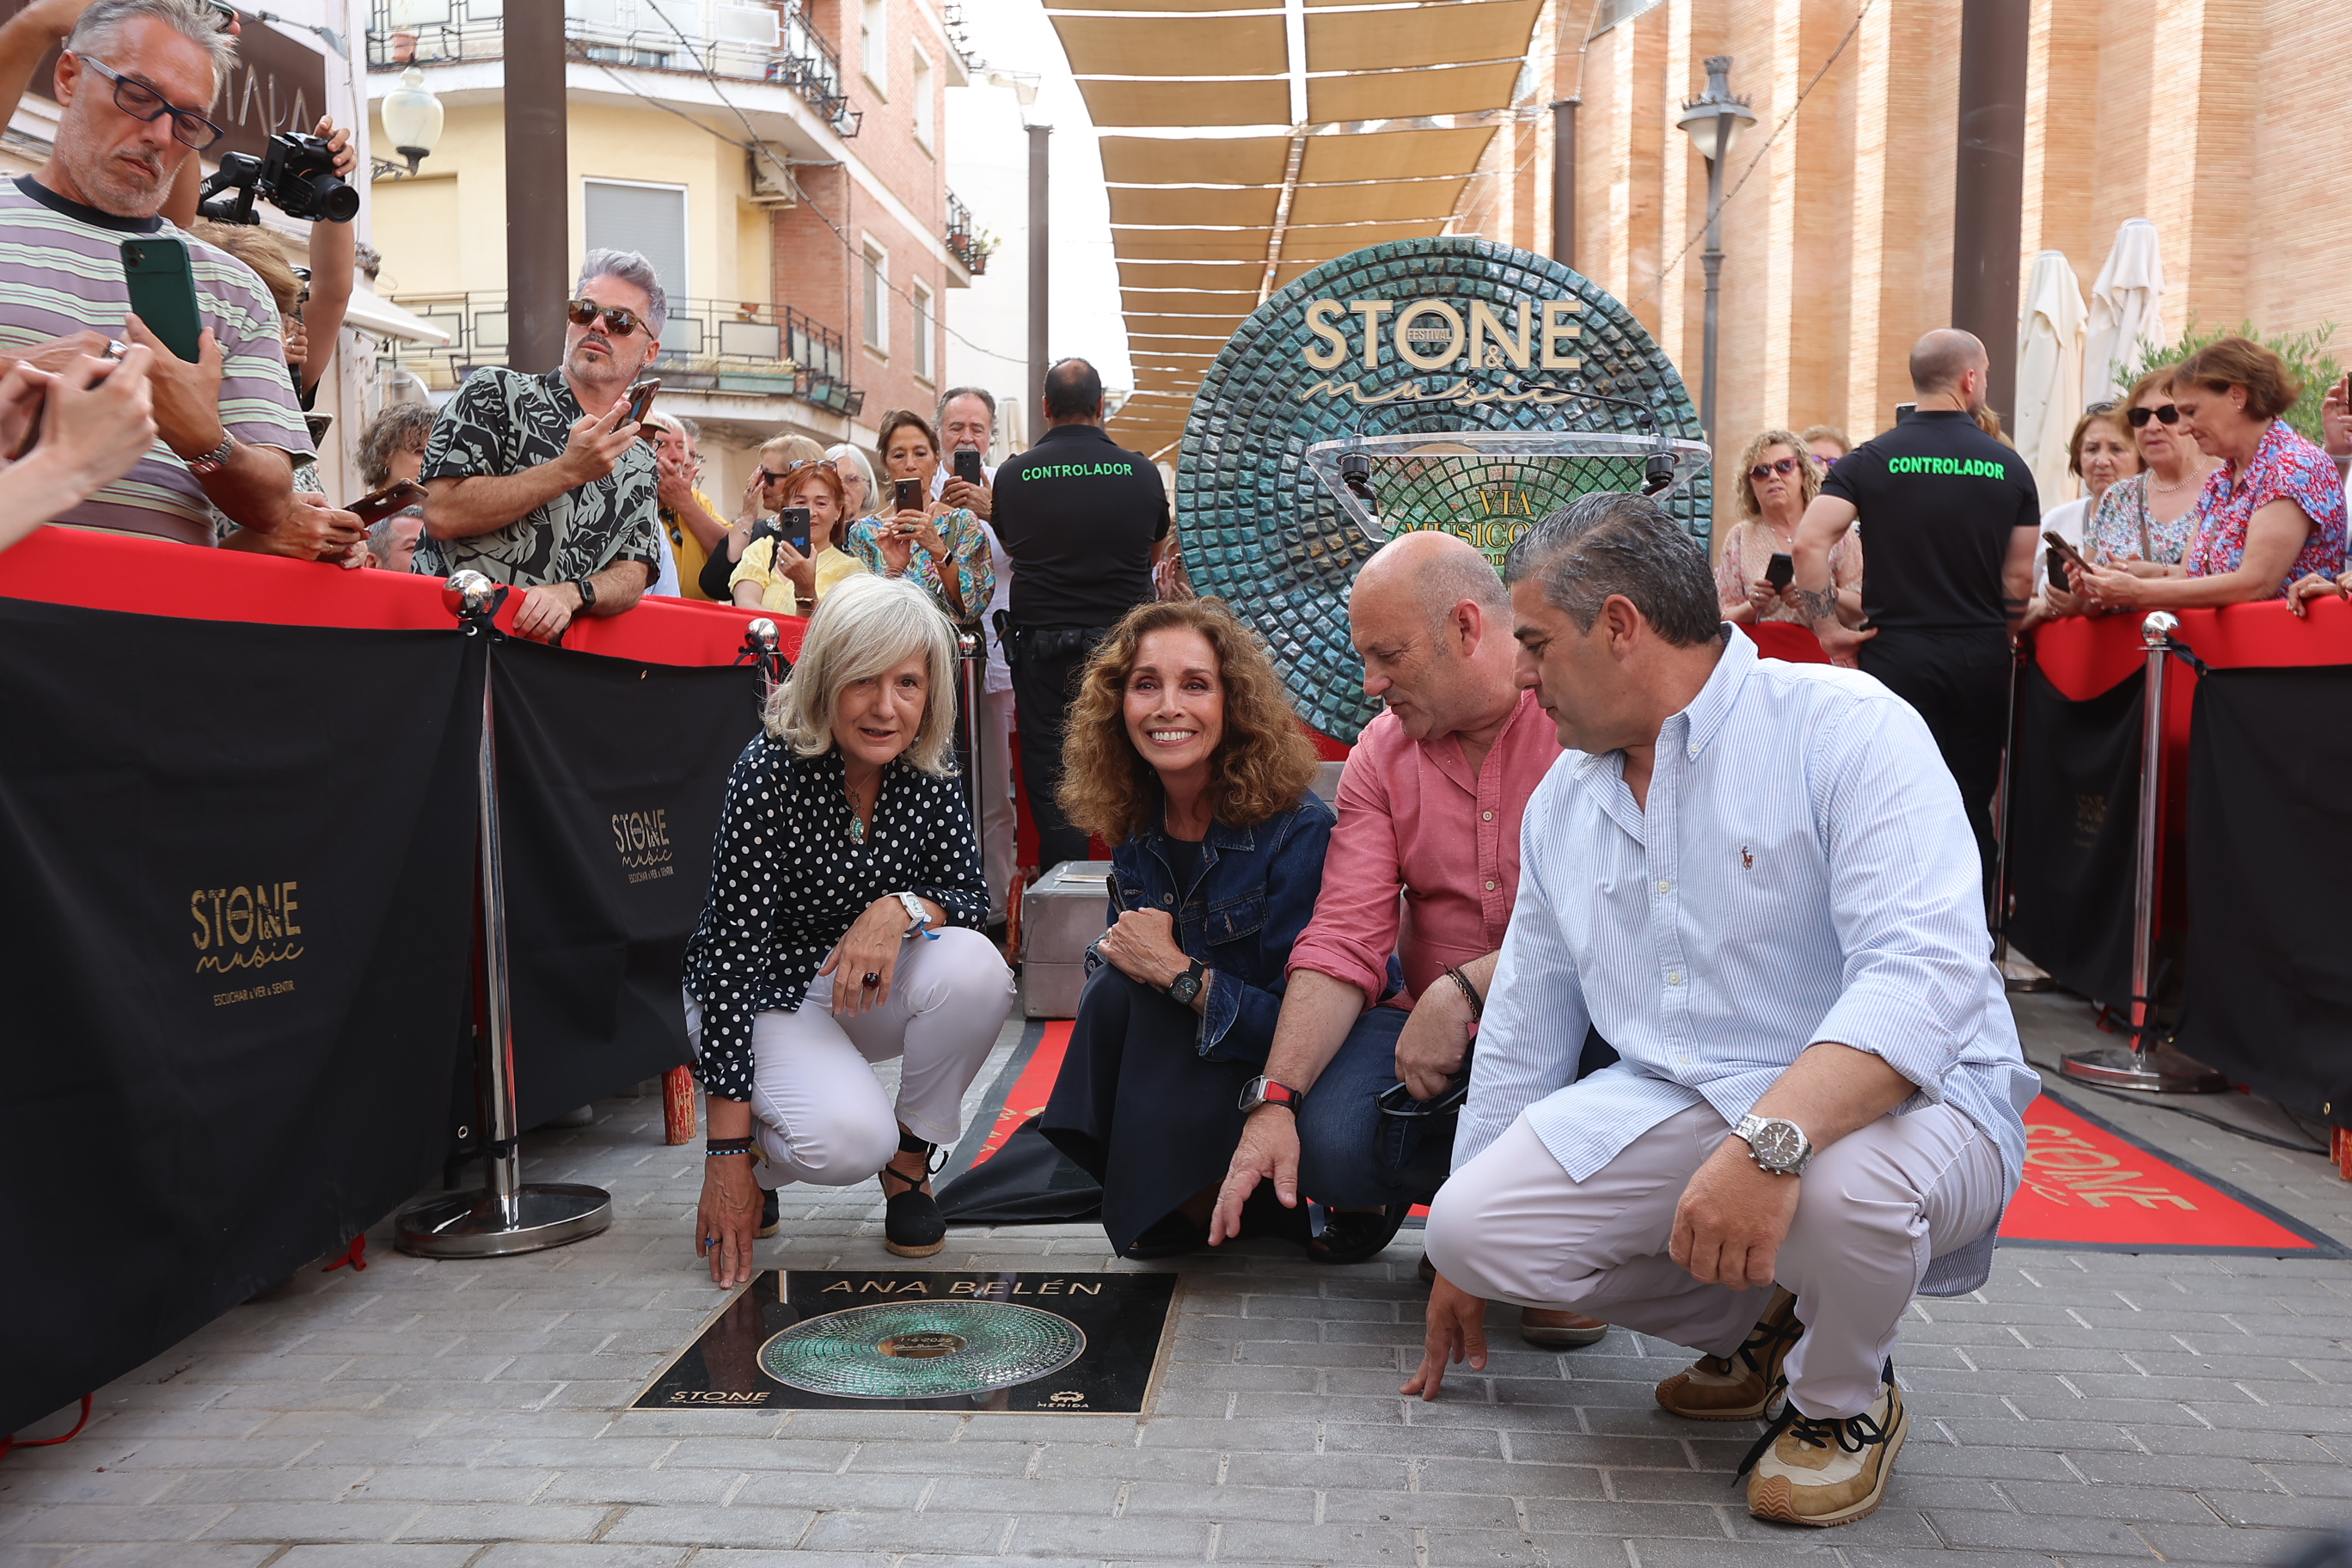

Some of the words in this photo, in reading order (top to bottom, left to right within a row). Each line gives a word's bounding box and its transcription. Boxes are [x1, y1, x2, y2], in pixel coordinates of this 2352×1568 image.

[1302, 297, 1583, 371] STONE
[1407, 328, 1452, 341] FESTIVAL
[1299, 373, 1581, 406] music
[1021, 462, 1134, 481] CONTROLADOR
[1888, 456, 2006, 481] CONTROLADOR
[1476, 489, 1535, 516] VIA
[611, 809, 670, 854] STONE
[622, 848, 673, 868] music
[191, 881, 302, 950] STONE
[195, 941, 304, 974] music
[213, 989, 249, 1007] ESCUCHAR
[253, 985, 266, 998] VER
[272, 980, 296, 995] SENTIR
[820, 1280, 929, 1294] ANA
[948, 1278, 1103, 1295] BELÉN
[670, 1390, 772, 1401] STONE
